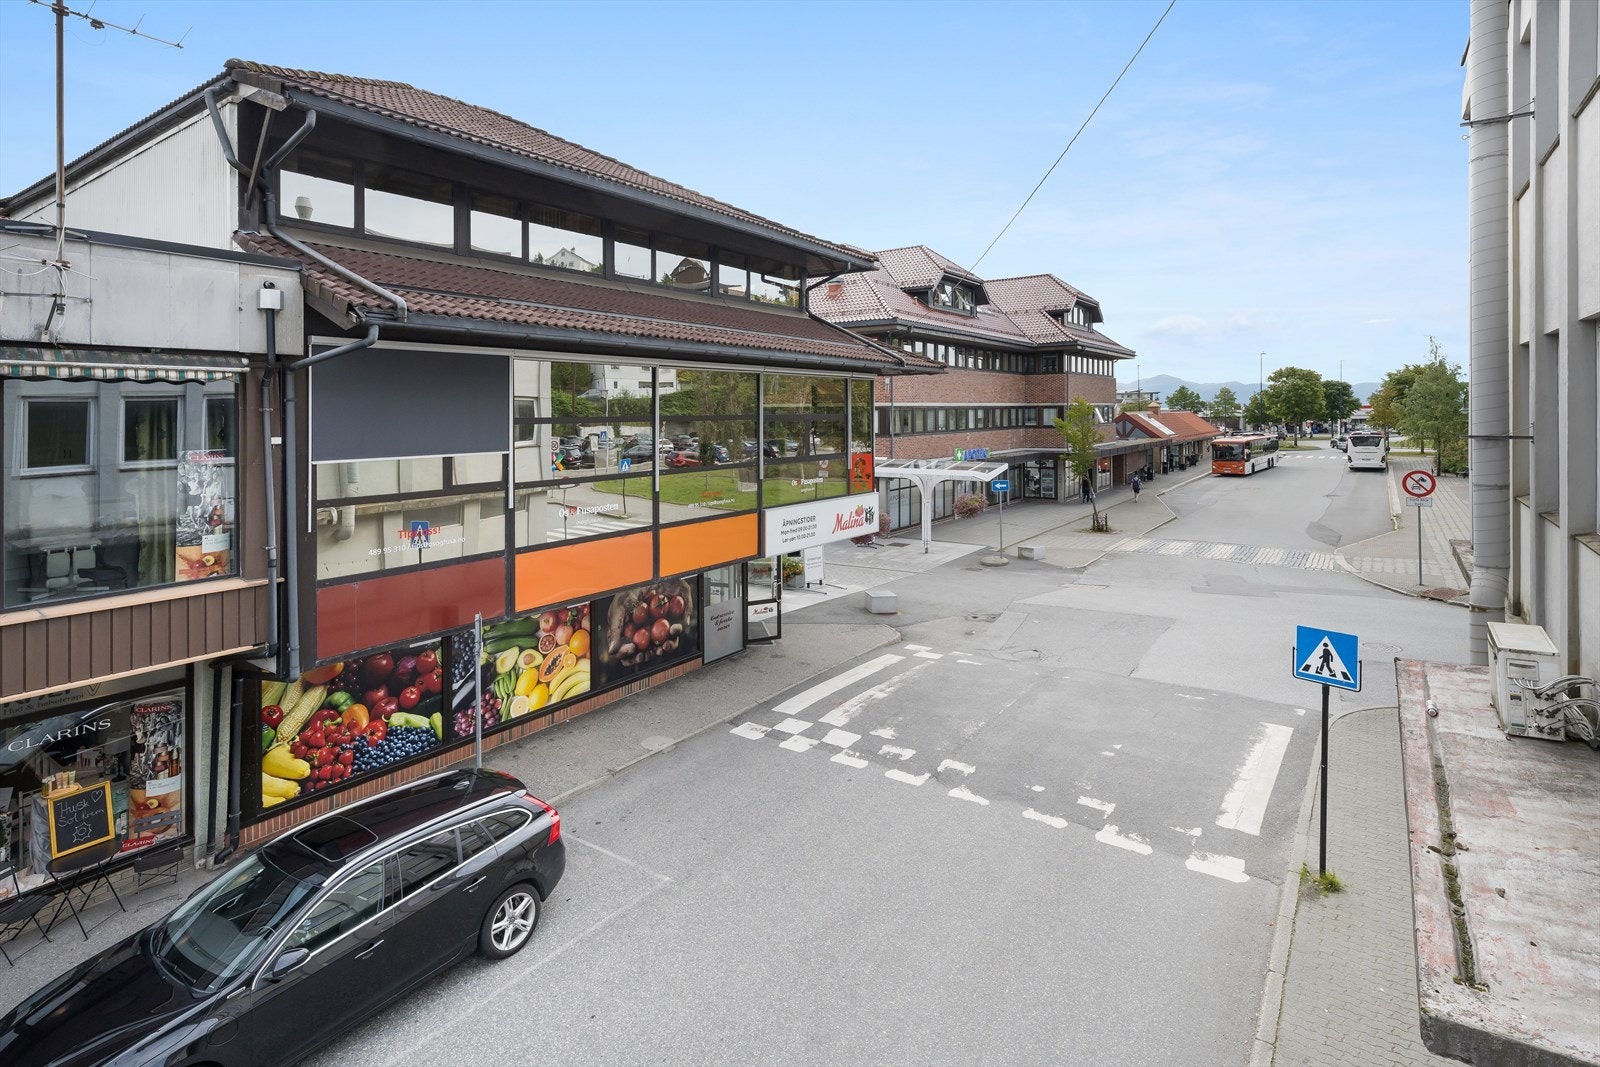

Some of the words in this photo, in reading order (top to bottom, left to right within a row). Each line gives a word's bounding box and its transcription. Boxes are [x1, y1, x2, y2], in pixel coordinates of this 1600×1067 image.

[782, 515, 817, 527] ÅPNINGSTIDER
[832, 511, 864, 534] Malina
[368, 548, 381, 556] 489
[383, 546, 392, 554] 95
[394, 543, 405, 552] 310
[136, 704, 173, 713] CLARINS
[8, 718, 112, 752] CLARINS
[57, 799, 90, 819] Husk
